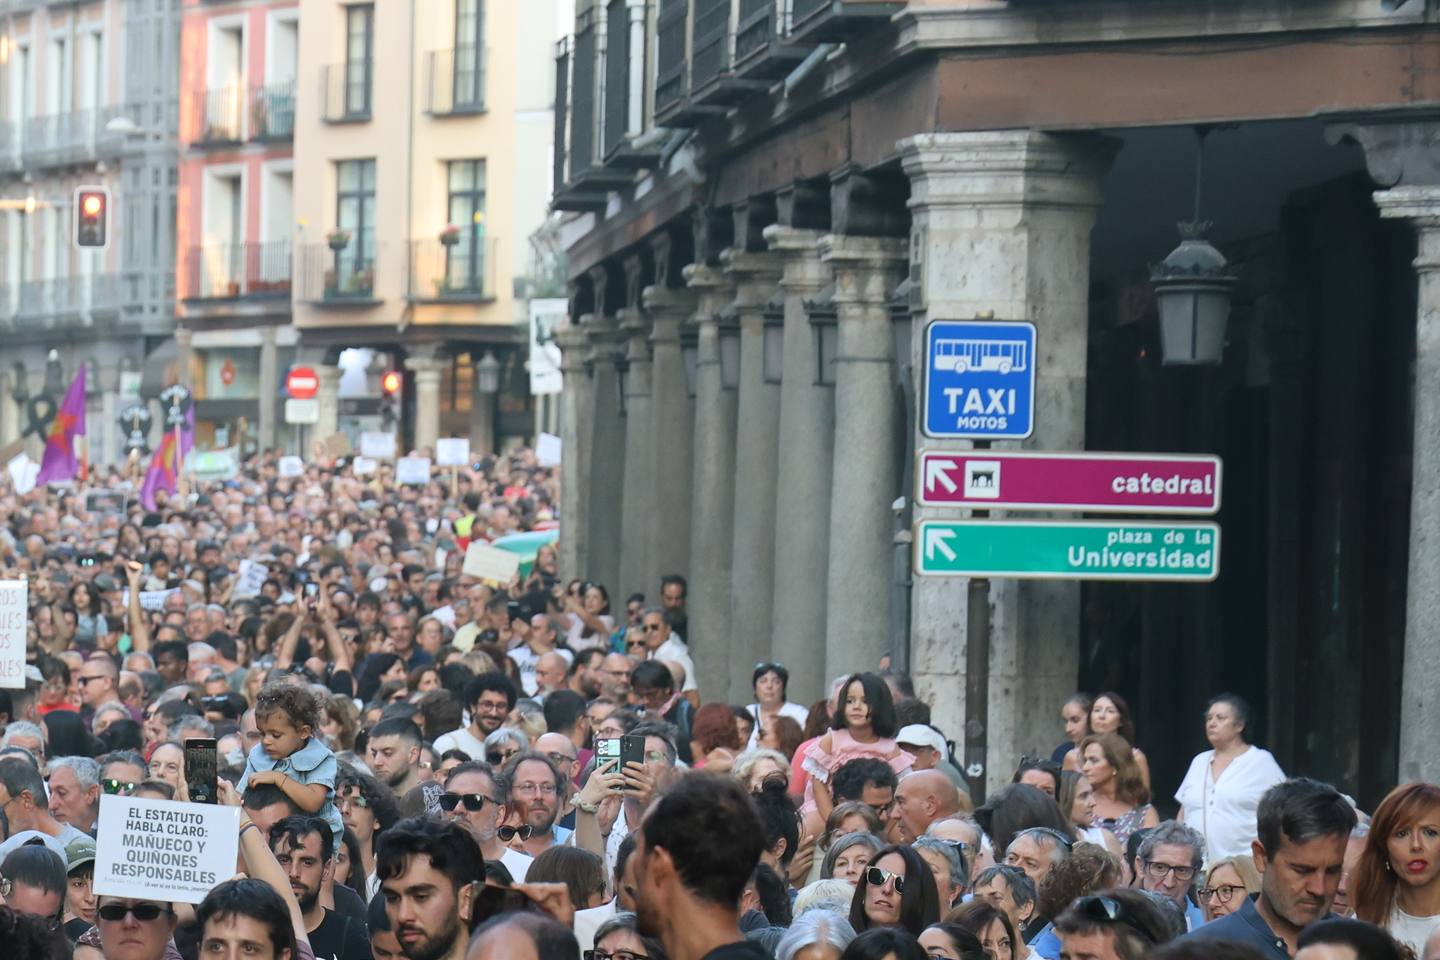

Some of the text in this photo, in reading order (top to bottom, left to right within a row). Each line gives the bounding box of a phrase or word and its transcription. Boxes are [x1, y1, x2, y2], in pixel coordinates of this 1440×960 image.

[943, 387, 1017, 415] TAXI
[956, 415, 1008, 430] MOTOS
[1111, 472, 1213, 495] catedral
[1107, 529, 1211, 547] plaza de la
[1067, 545, 1211, 569] Universidad
[128, 807, 204, 825] EL ESTATUTO
[125, 820, 209, 838] HABLA CLARO:
[122, 833, 207, 853] MAÑUECO Y
[126, 849, 199, 868] QUIÑONES
[111, 862, 217, 884] RESPONSABLES
